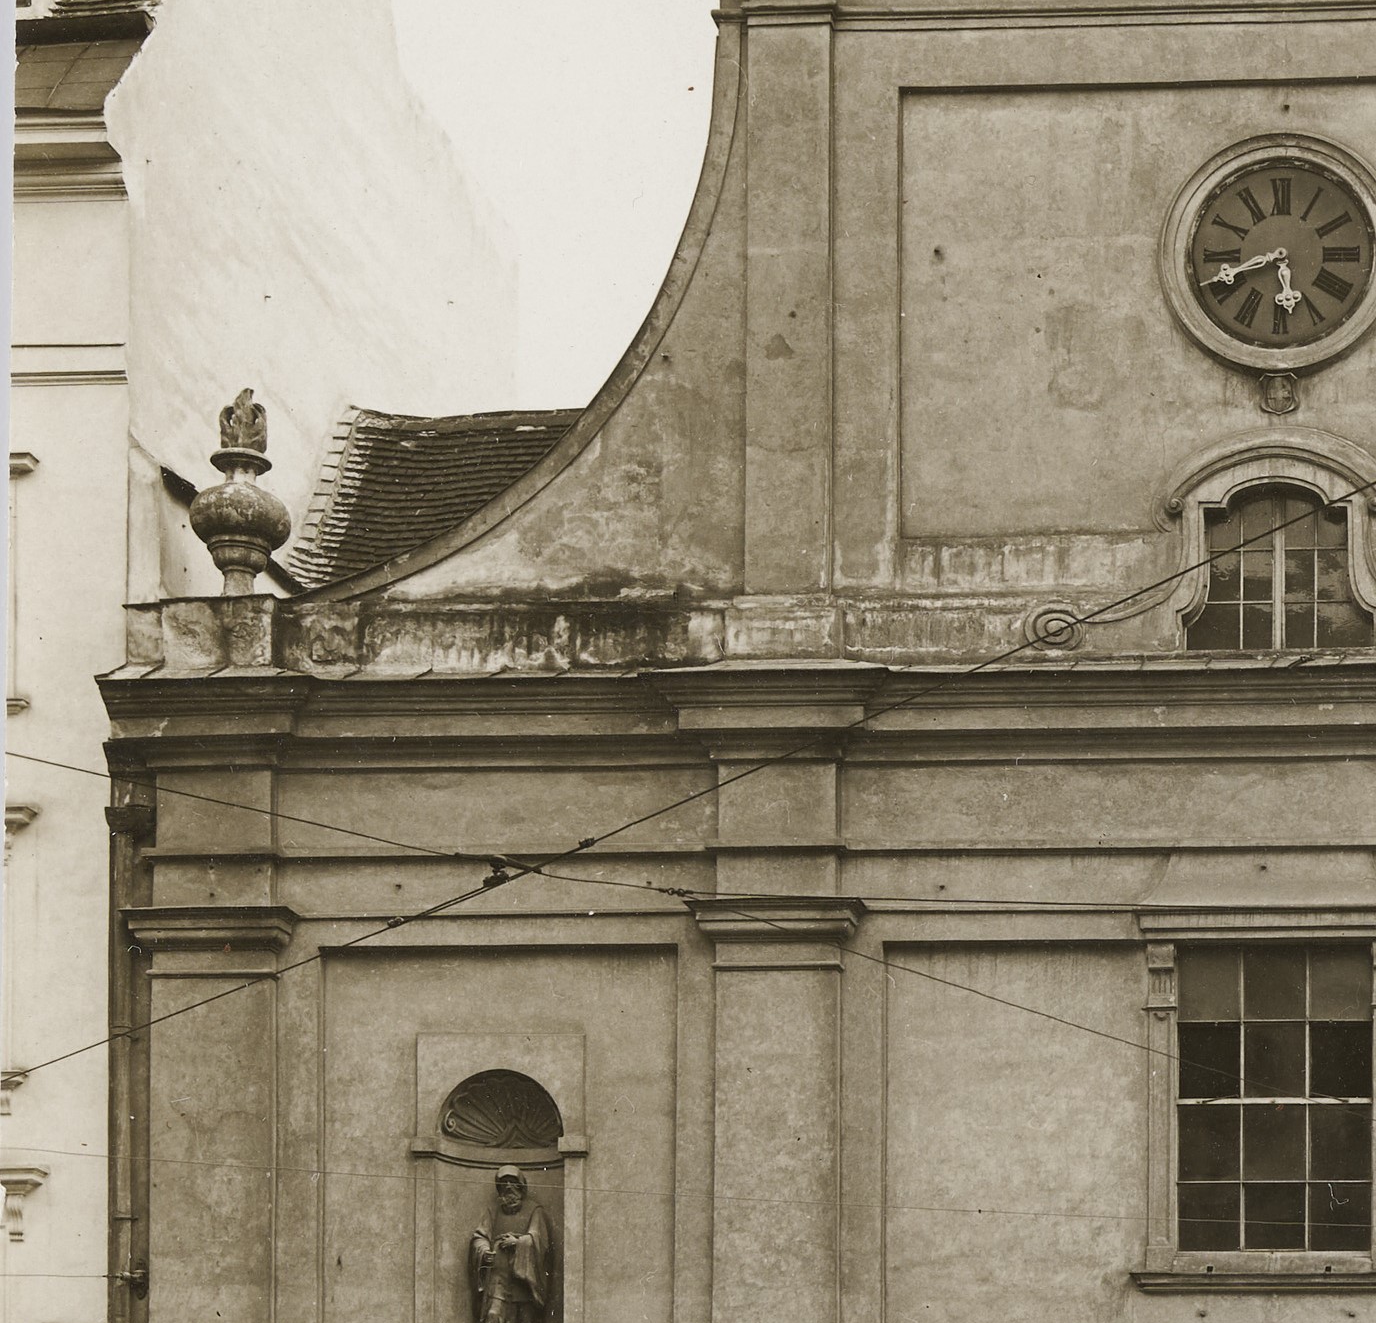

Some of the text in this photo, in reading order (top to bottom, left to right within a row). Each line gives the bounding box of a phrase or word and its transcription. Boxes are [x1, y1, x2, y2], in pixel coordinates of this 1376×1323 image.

[1236, 186, 1267, 226] XI
[1270, 179, 1291, 215] XII
[1300, 186, 1324, 221] I
[1211, 213, 1250, 241] X
[1315, 211, 1352, 239] II
[1203, 248, 1241, 263] IX
[1322, 245, 1360, 263] III
[1233, 287, 1263, 328] VII
[1301, 292, 1325, 326] V
